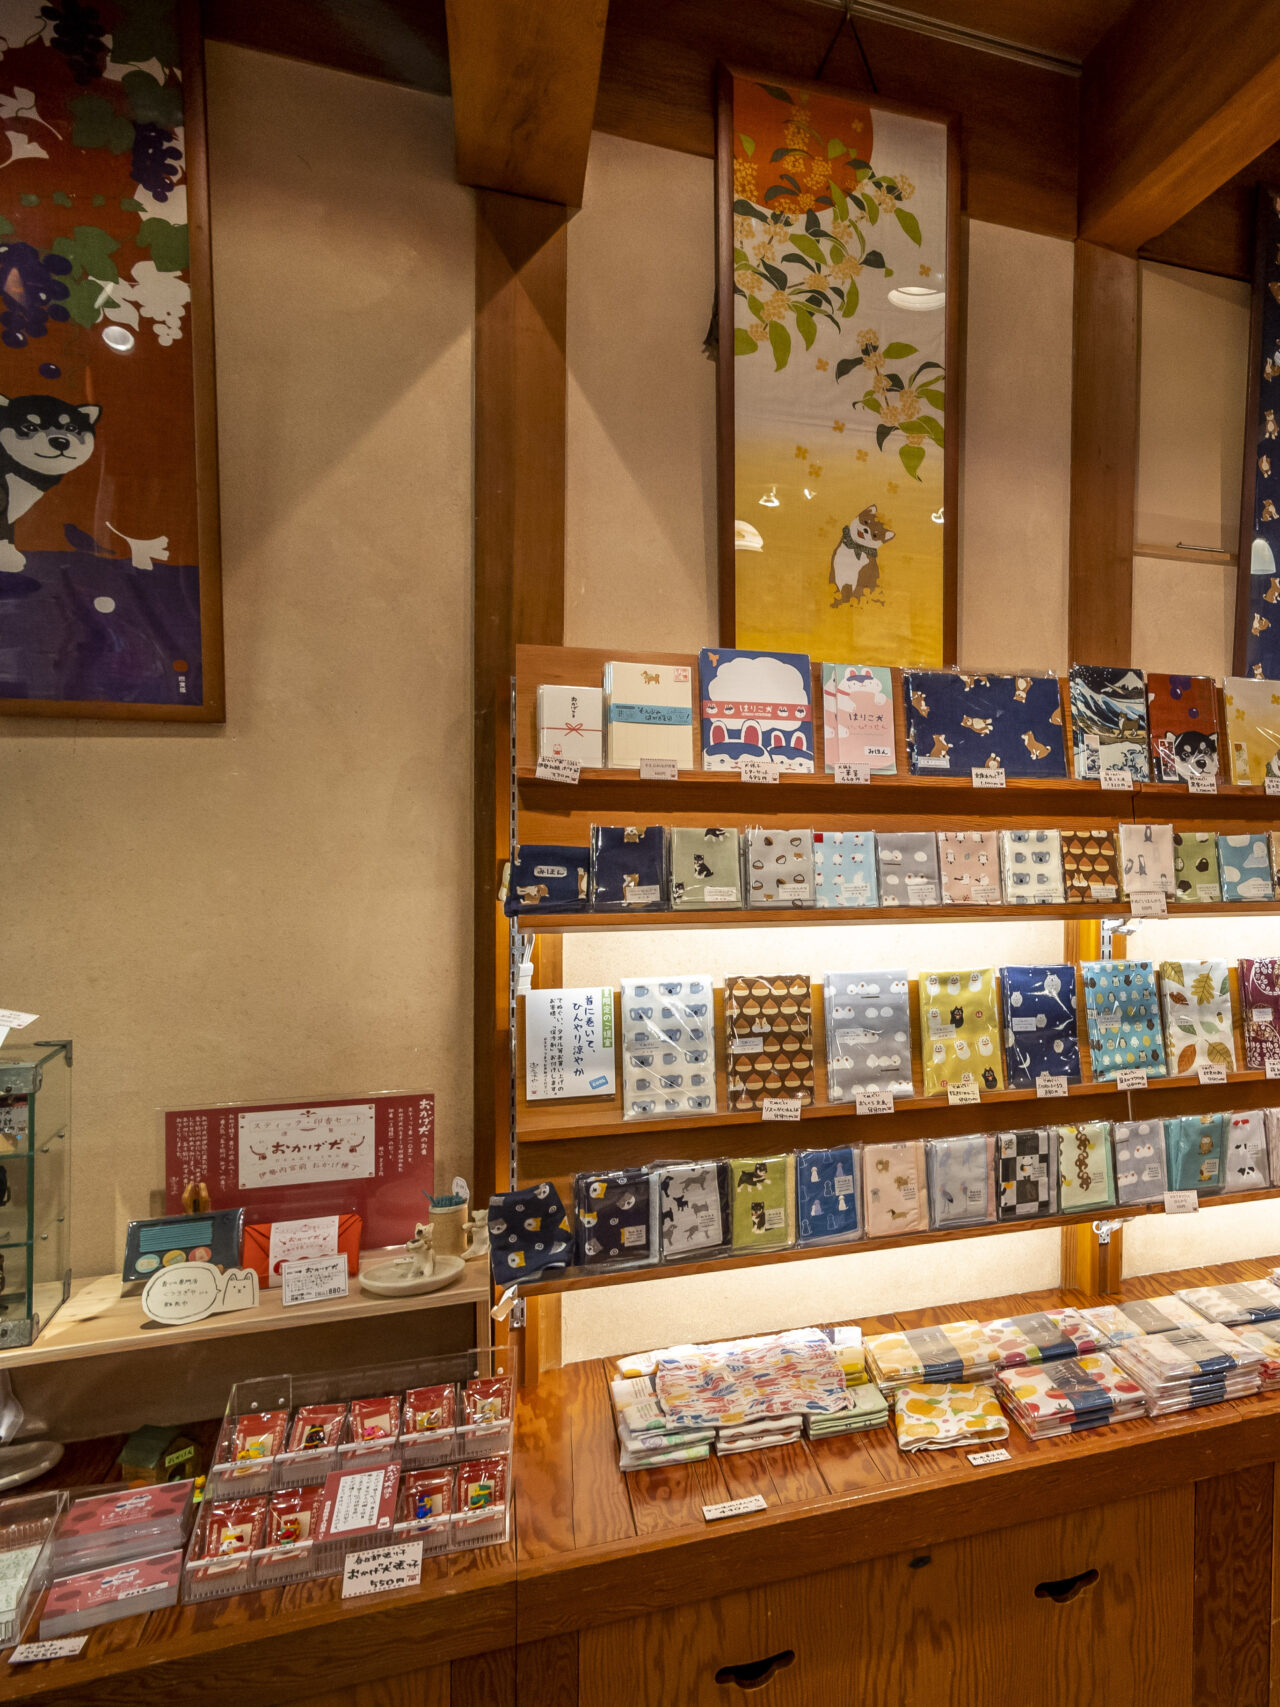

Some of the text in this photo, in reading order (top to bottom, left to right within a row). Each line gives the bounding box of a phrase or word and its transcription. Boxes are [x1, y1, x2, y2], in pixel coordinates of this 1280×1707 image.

[739, 703, 773, 713] はりこ犬
[848, 712, 884, 722] はりこ犬
[534, 865, 568, 877] みほん
[585, 994, 596, 1053] 首に巻いて、
[573, 1002, 585, 1077] ひんやり涼やか
[328, 1287, 341, 1295] 880
[370, 1577, 405, 1587] 550円
